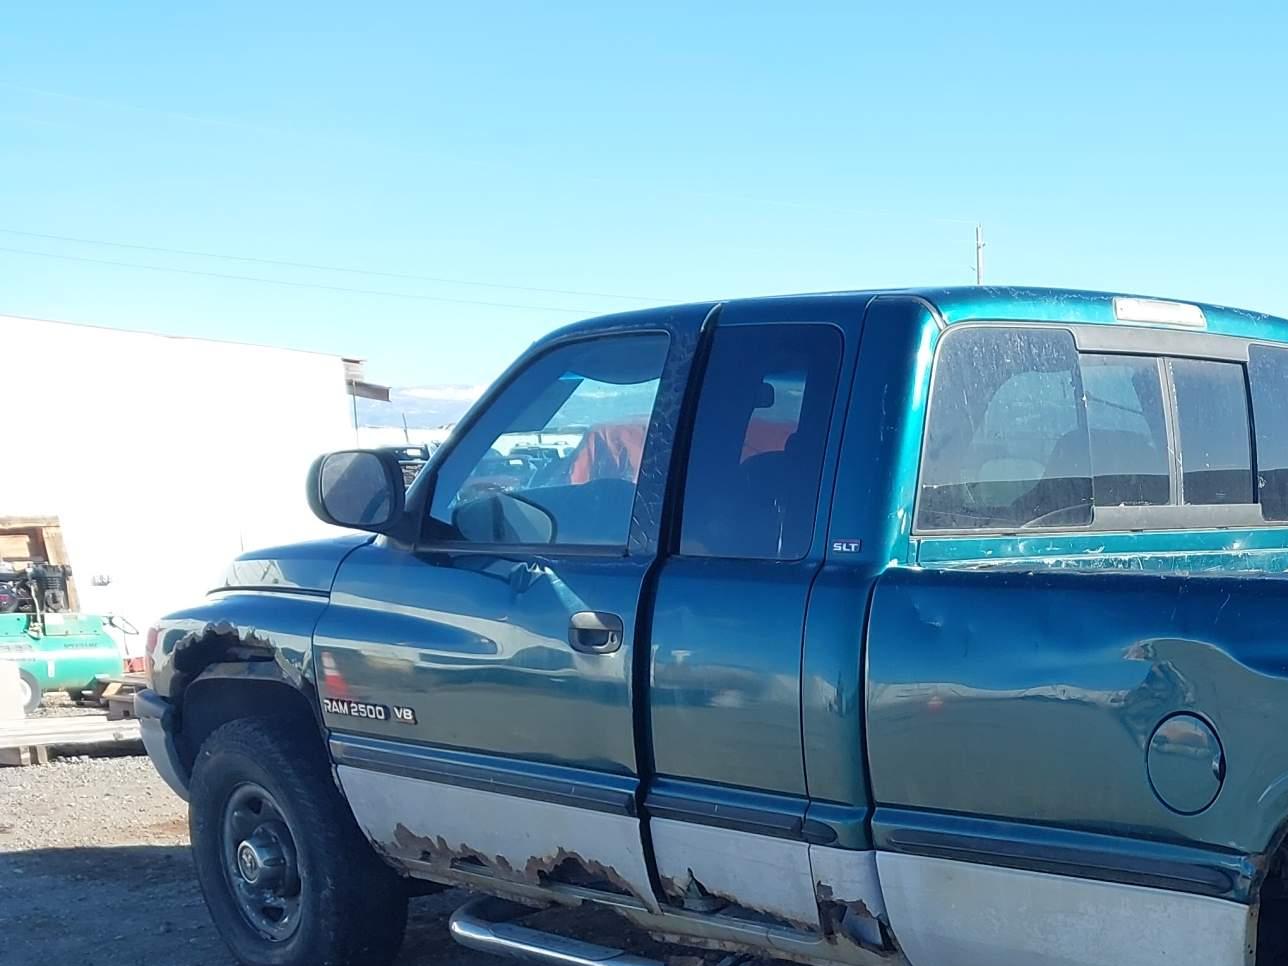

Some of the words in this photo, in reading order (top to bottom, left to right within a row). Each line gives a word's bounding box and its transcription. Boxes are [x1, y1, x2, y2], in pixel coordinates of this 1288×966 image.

[832, 542, 860, 552] SLT
[323, 699, 349, 715] RAM
[350, 703, 385, 720] 2500
[393, 706, 414, 720] V8
